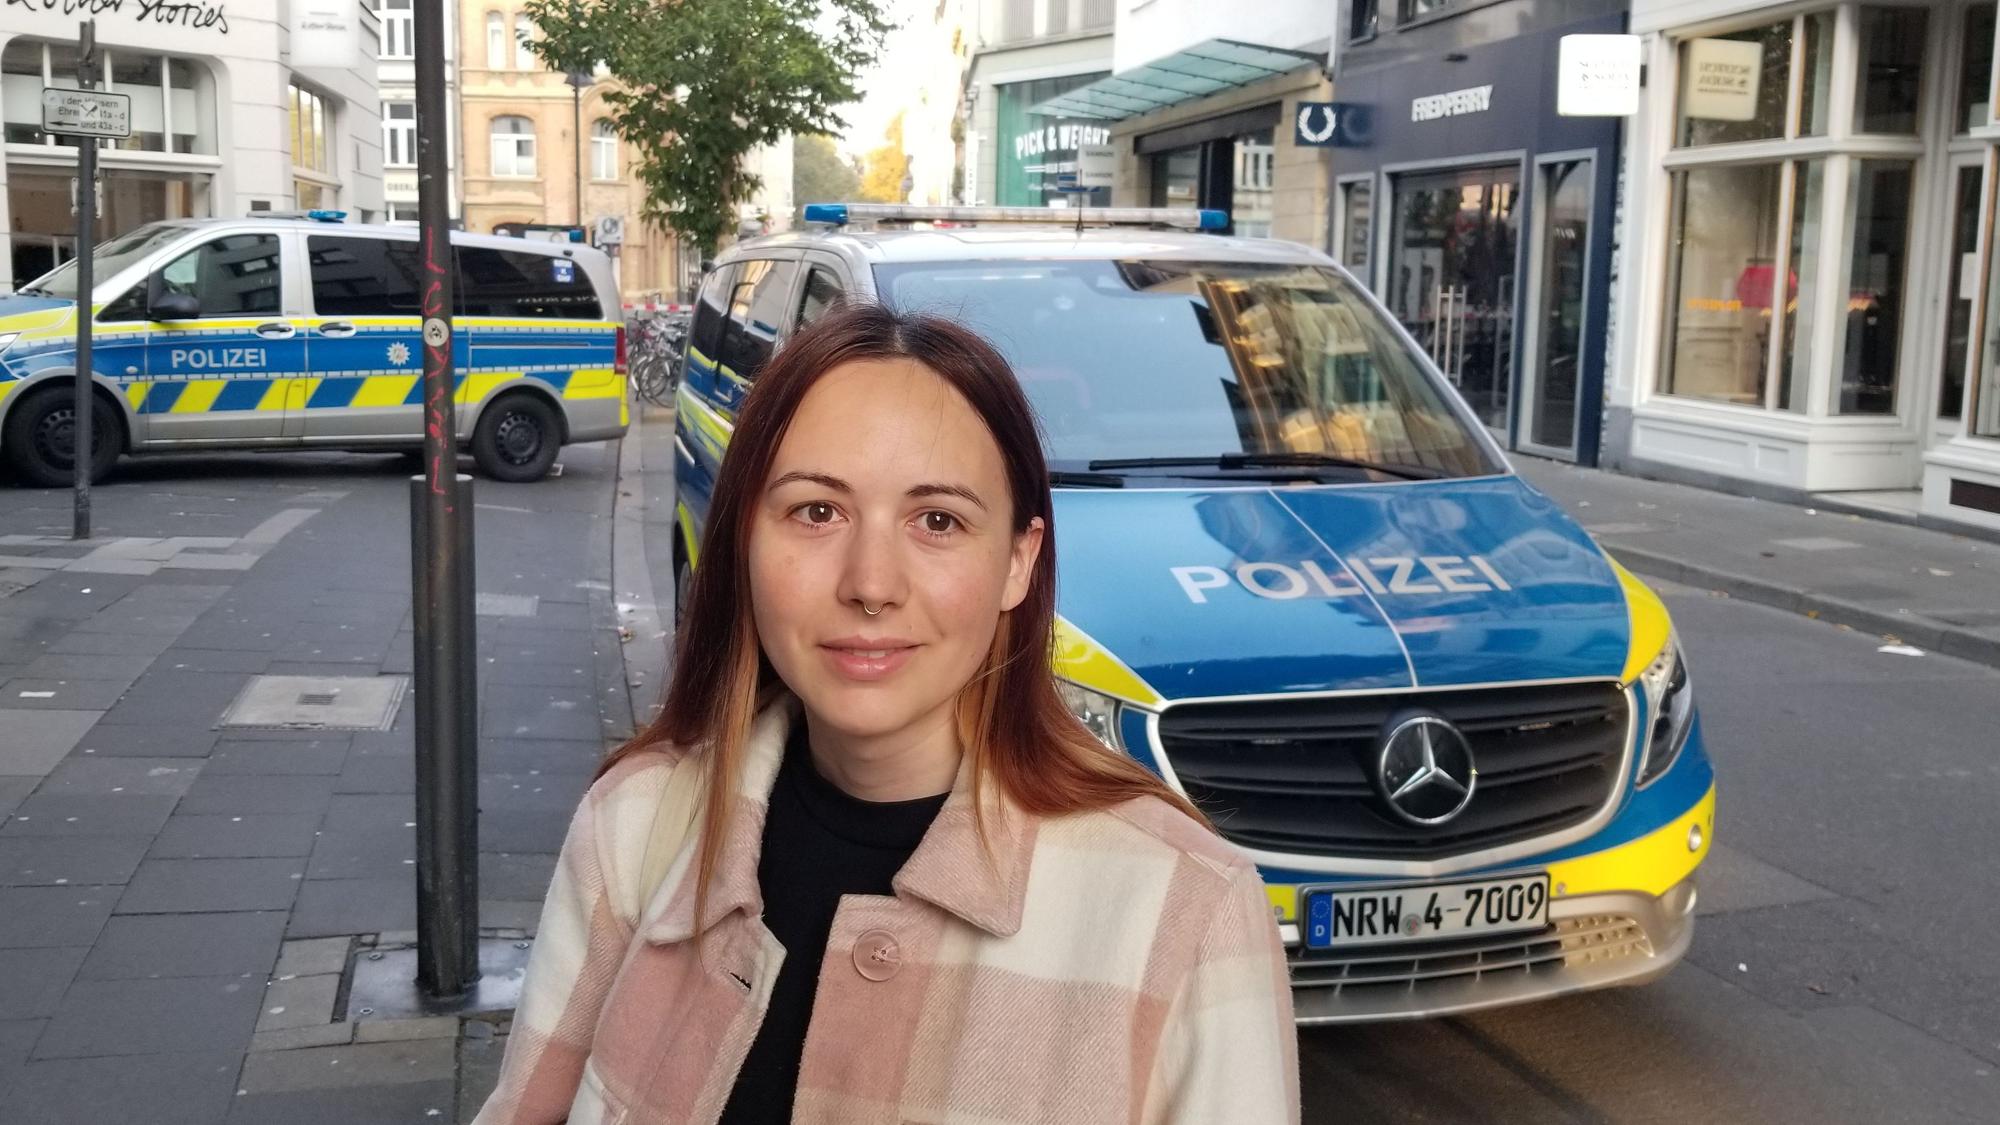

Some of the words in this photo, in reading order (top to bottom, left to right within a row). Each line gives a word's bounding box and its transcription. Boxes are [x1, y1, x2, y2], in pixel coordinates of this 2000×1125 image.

[136, 0, 228, 34] Stories
[1016, 129, 1045, 160] PICK
[1047, 125, 1057, 151] &
[1059, 125, 1110, 150] WEIGHT
[171, 348, 267, 368] POLIZEI
[1169, 555, 1512, 604] POLIZEI
[1315, 924, 1326, 937] D
[1333, 895, 1402, 938] NRW
